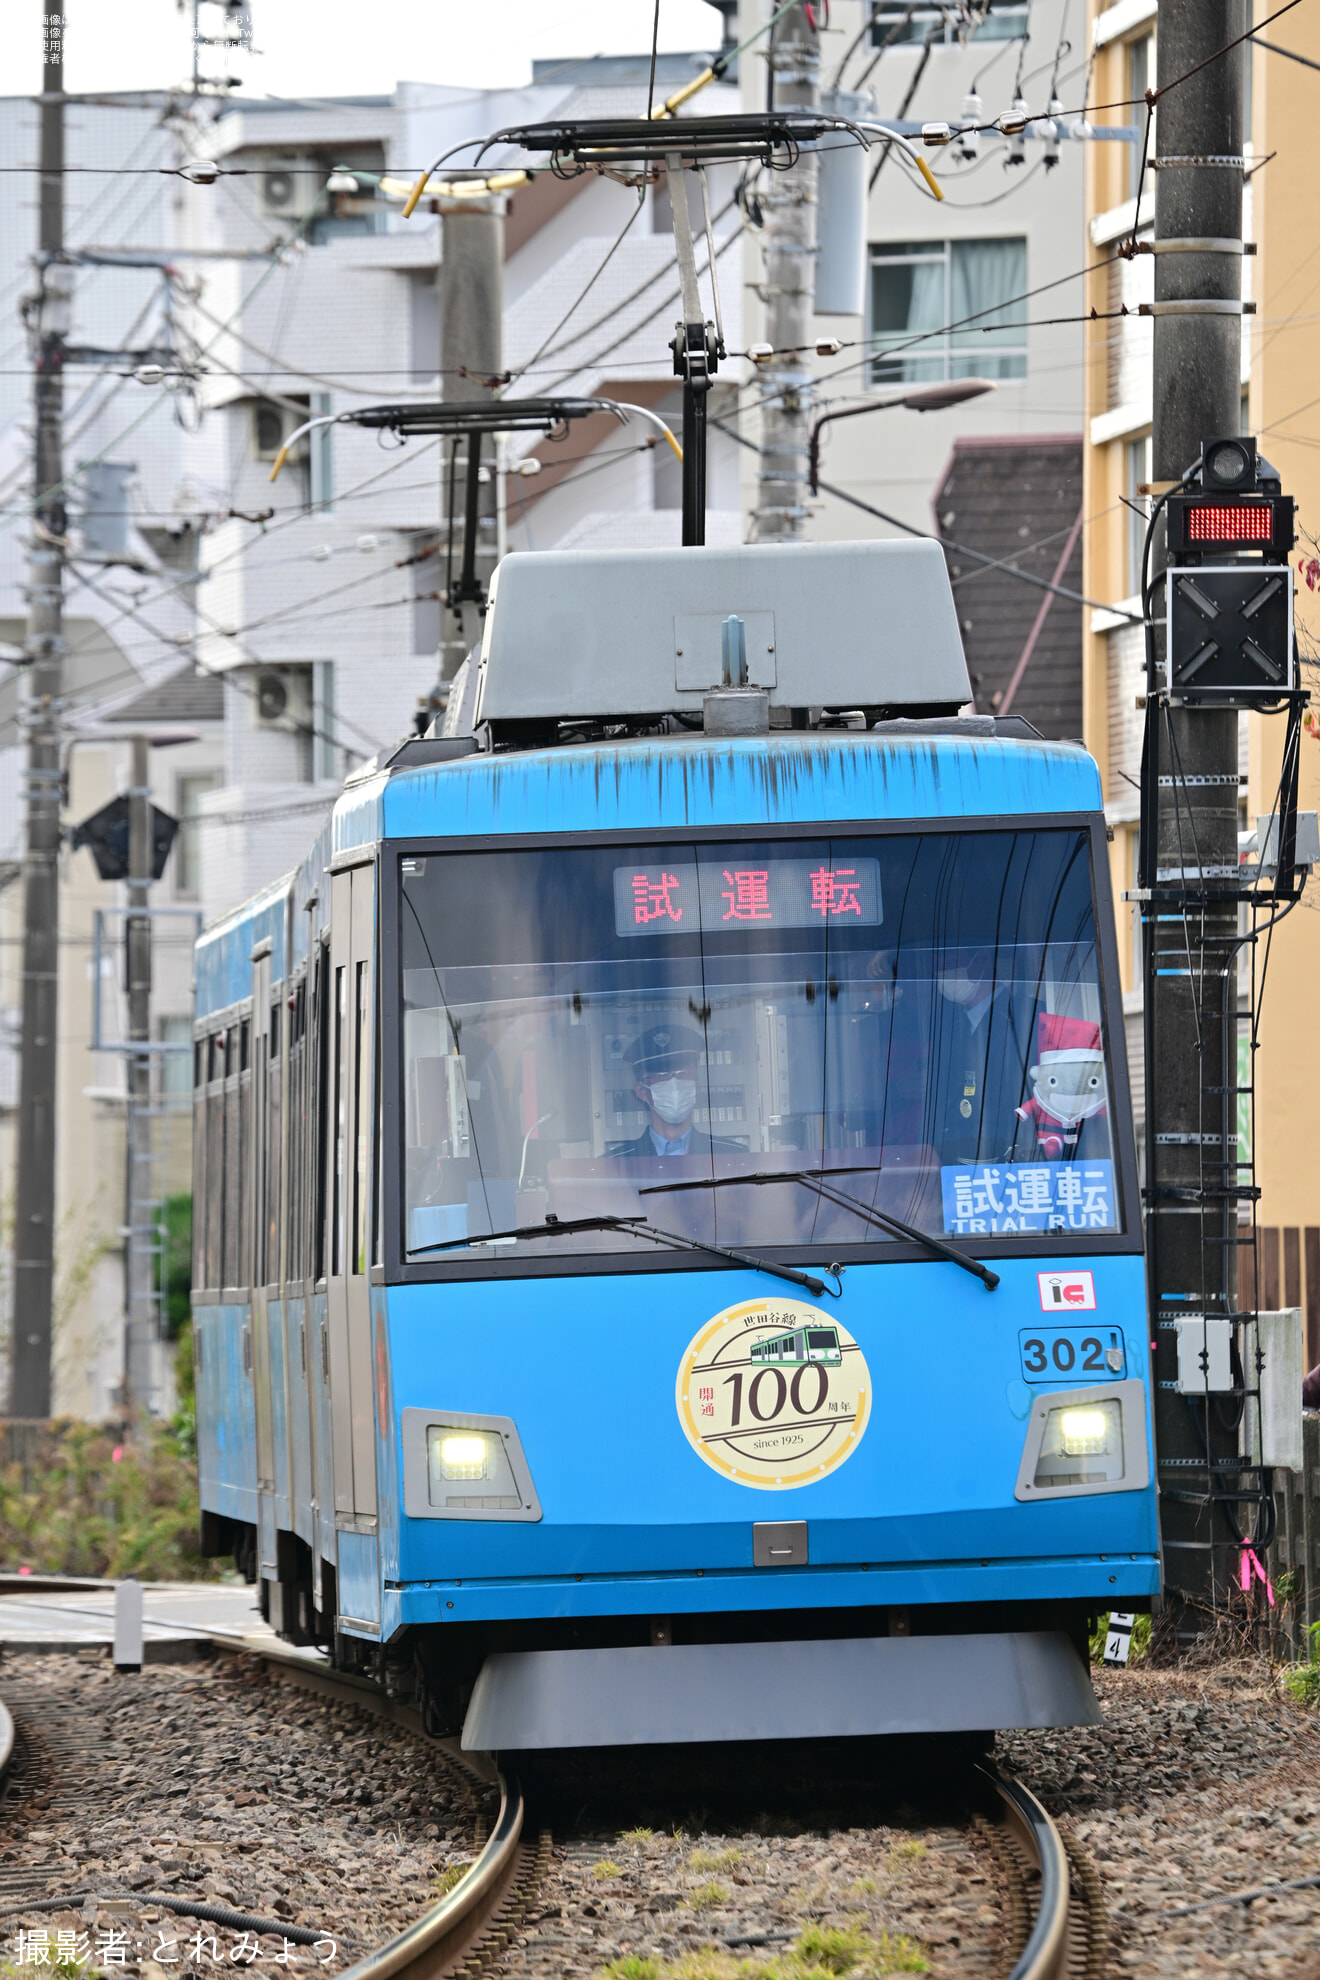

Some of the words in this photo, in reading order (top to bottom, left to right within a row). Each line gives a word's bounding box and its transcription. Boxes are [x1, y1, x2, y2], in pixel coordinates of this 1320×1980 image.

[632, 867, 861, 923] 試運転
[954, 1166, 1109, 1218] 試運転
[952, 1216, 1037, 1233] TRIAL
[1049, 1213, 1108, 1229] RUN
[743, 1312, 797, 1327] 世田谷線
[1024, 1337, 1105, 1372] 302
[699, 1387, 715, 1417] 開通
[722, 1361, 829, 1427] 100
[828, 1401, 851, 1413] 周年
[753, 1436, 779, 1449] since
[781, 1435, 804, 1446] 1925
[1109, 1637, 1121, 1658] 4
